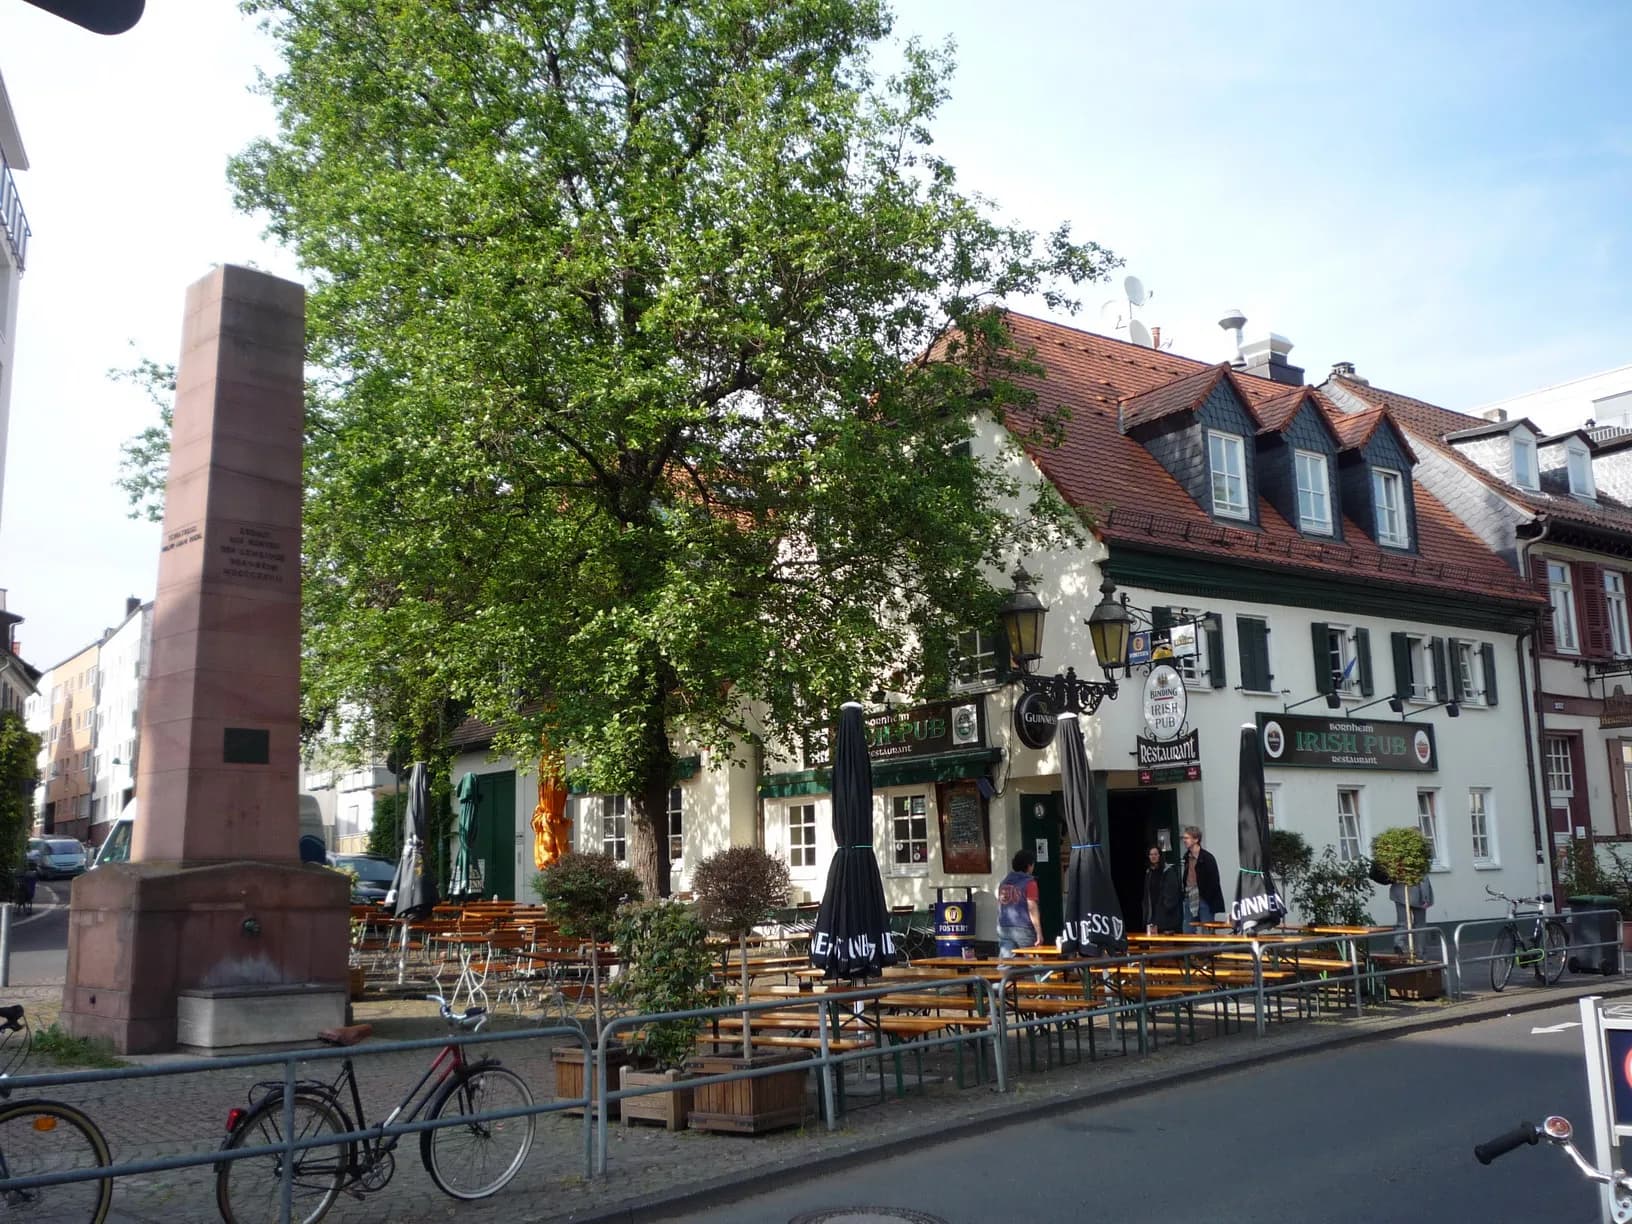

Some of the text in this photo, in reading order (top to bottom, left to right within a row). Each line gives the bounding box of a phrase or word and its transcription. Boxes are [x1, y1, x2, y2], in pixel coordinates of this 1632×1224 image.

[1150, 687, 1178, 699] BINDING
[1151, 702, 1178, 716] IRISH
[1155, 716, 1176, 729] PUB
[896, 719, 946, 743] PUB
[1296, 730, 1407, 756] IRISH PUB
